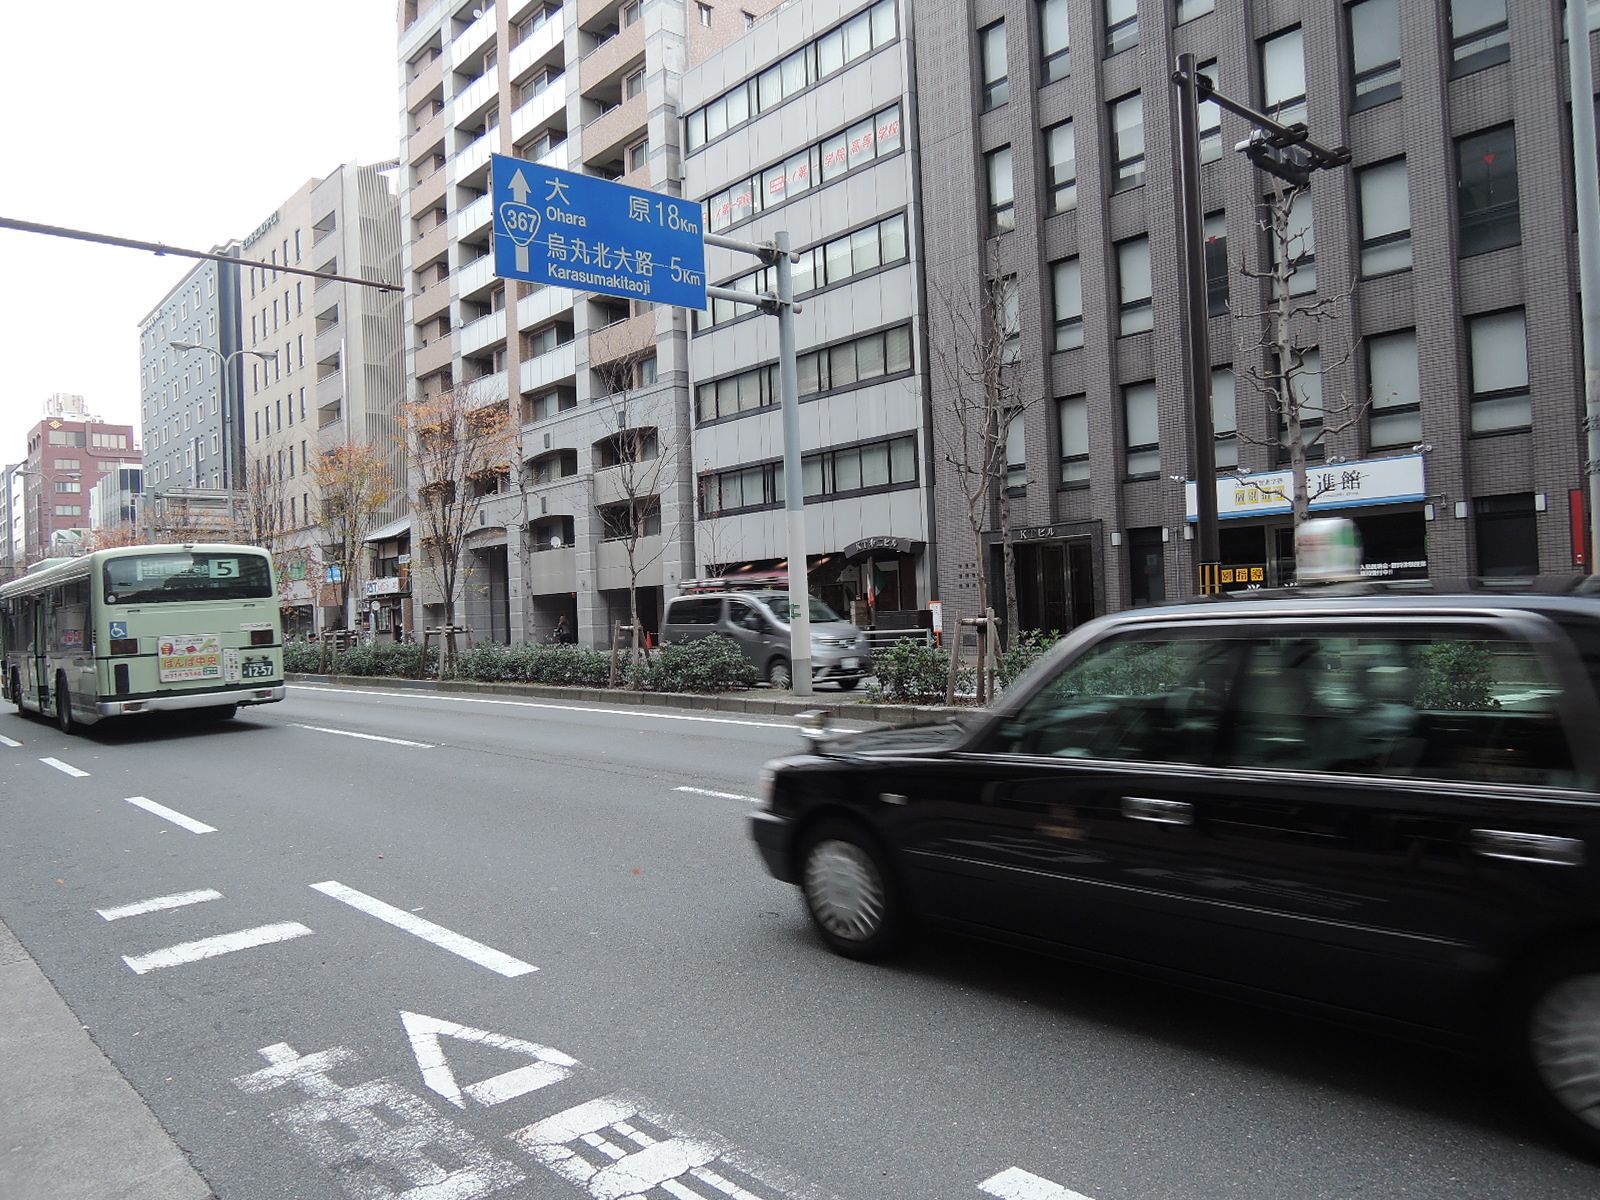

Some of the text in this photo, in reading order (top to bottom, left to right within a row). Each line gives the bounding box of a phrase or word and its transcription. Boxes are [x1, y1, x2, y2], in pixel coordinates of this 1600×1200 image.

[506, 209, 537, 234] 367
[546, 206, 588, 228] Ohara
[547, 263, 651, 296] Karasumakitaoji
[670, 256, 701, 286] 5Km
[217, 561, 233, 577] 5
